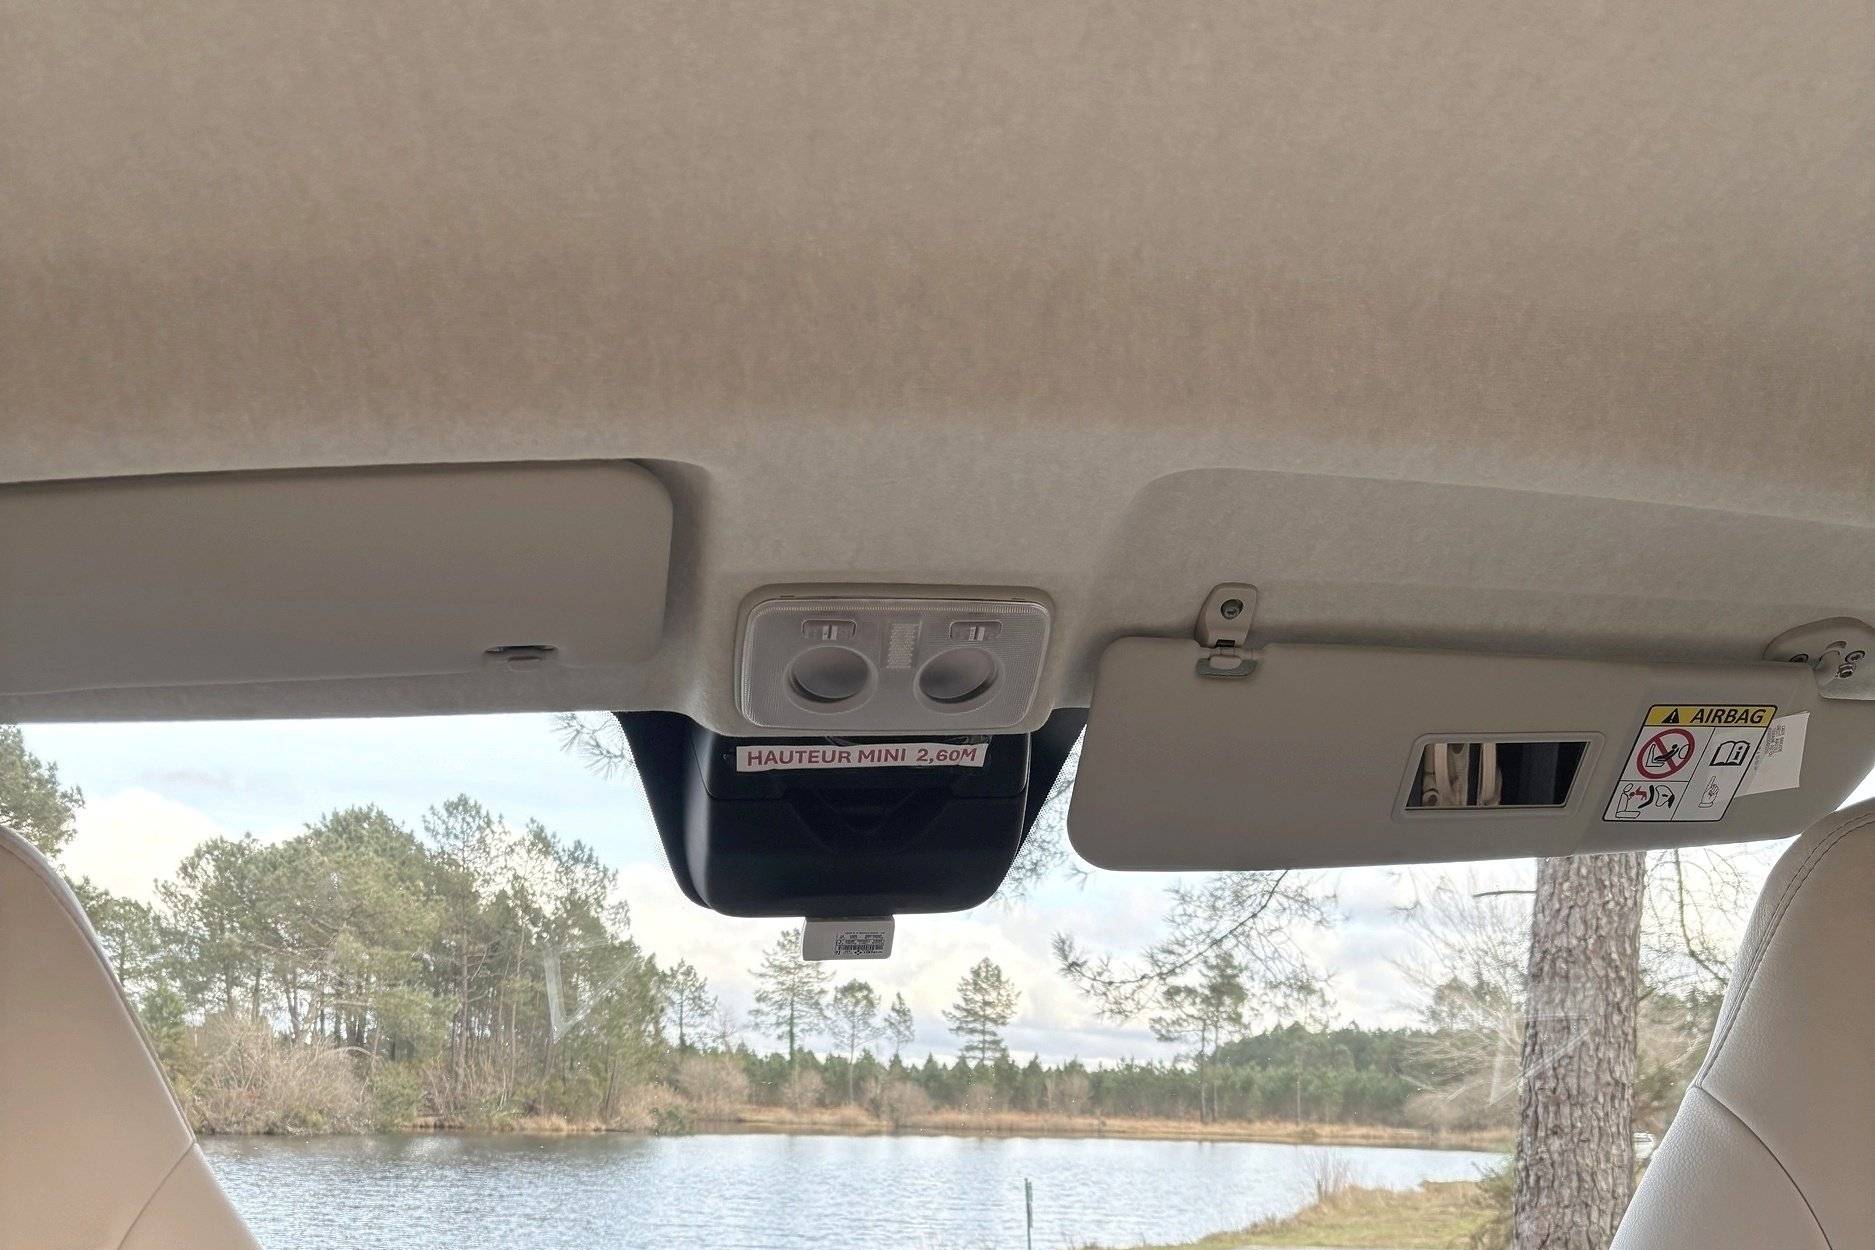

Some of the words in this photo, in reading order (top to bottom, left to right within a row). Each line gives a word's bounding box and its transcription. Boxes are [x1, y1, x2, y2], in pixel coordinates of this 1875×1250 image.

[1690, 708, 1767, 724] AIRBAG
[747, 749, 852, 767] HAUTEUR
[858, 748, 907, 763] MINI
[916, 748, 977, 763] 2,60M
